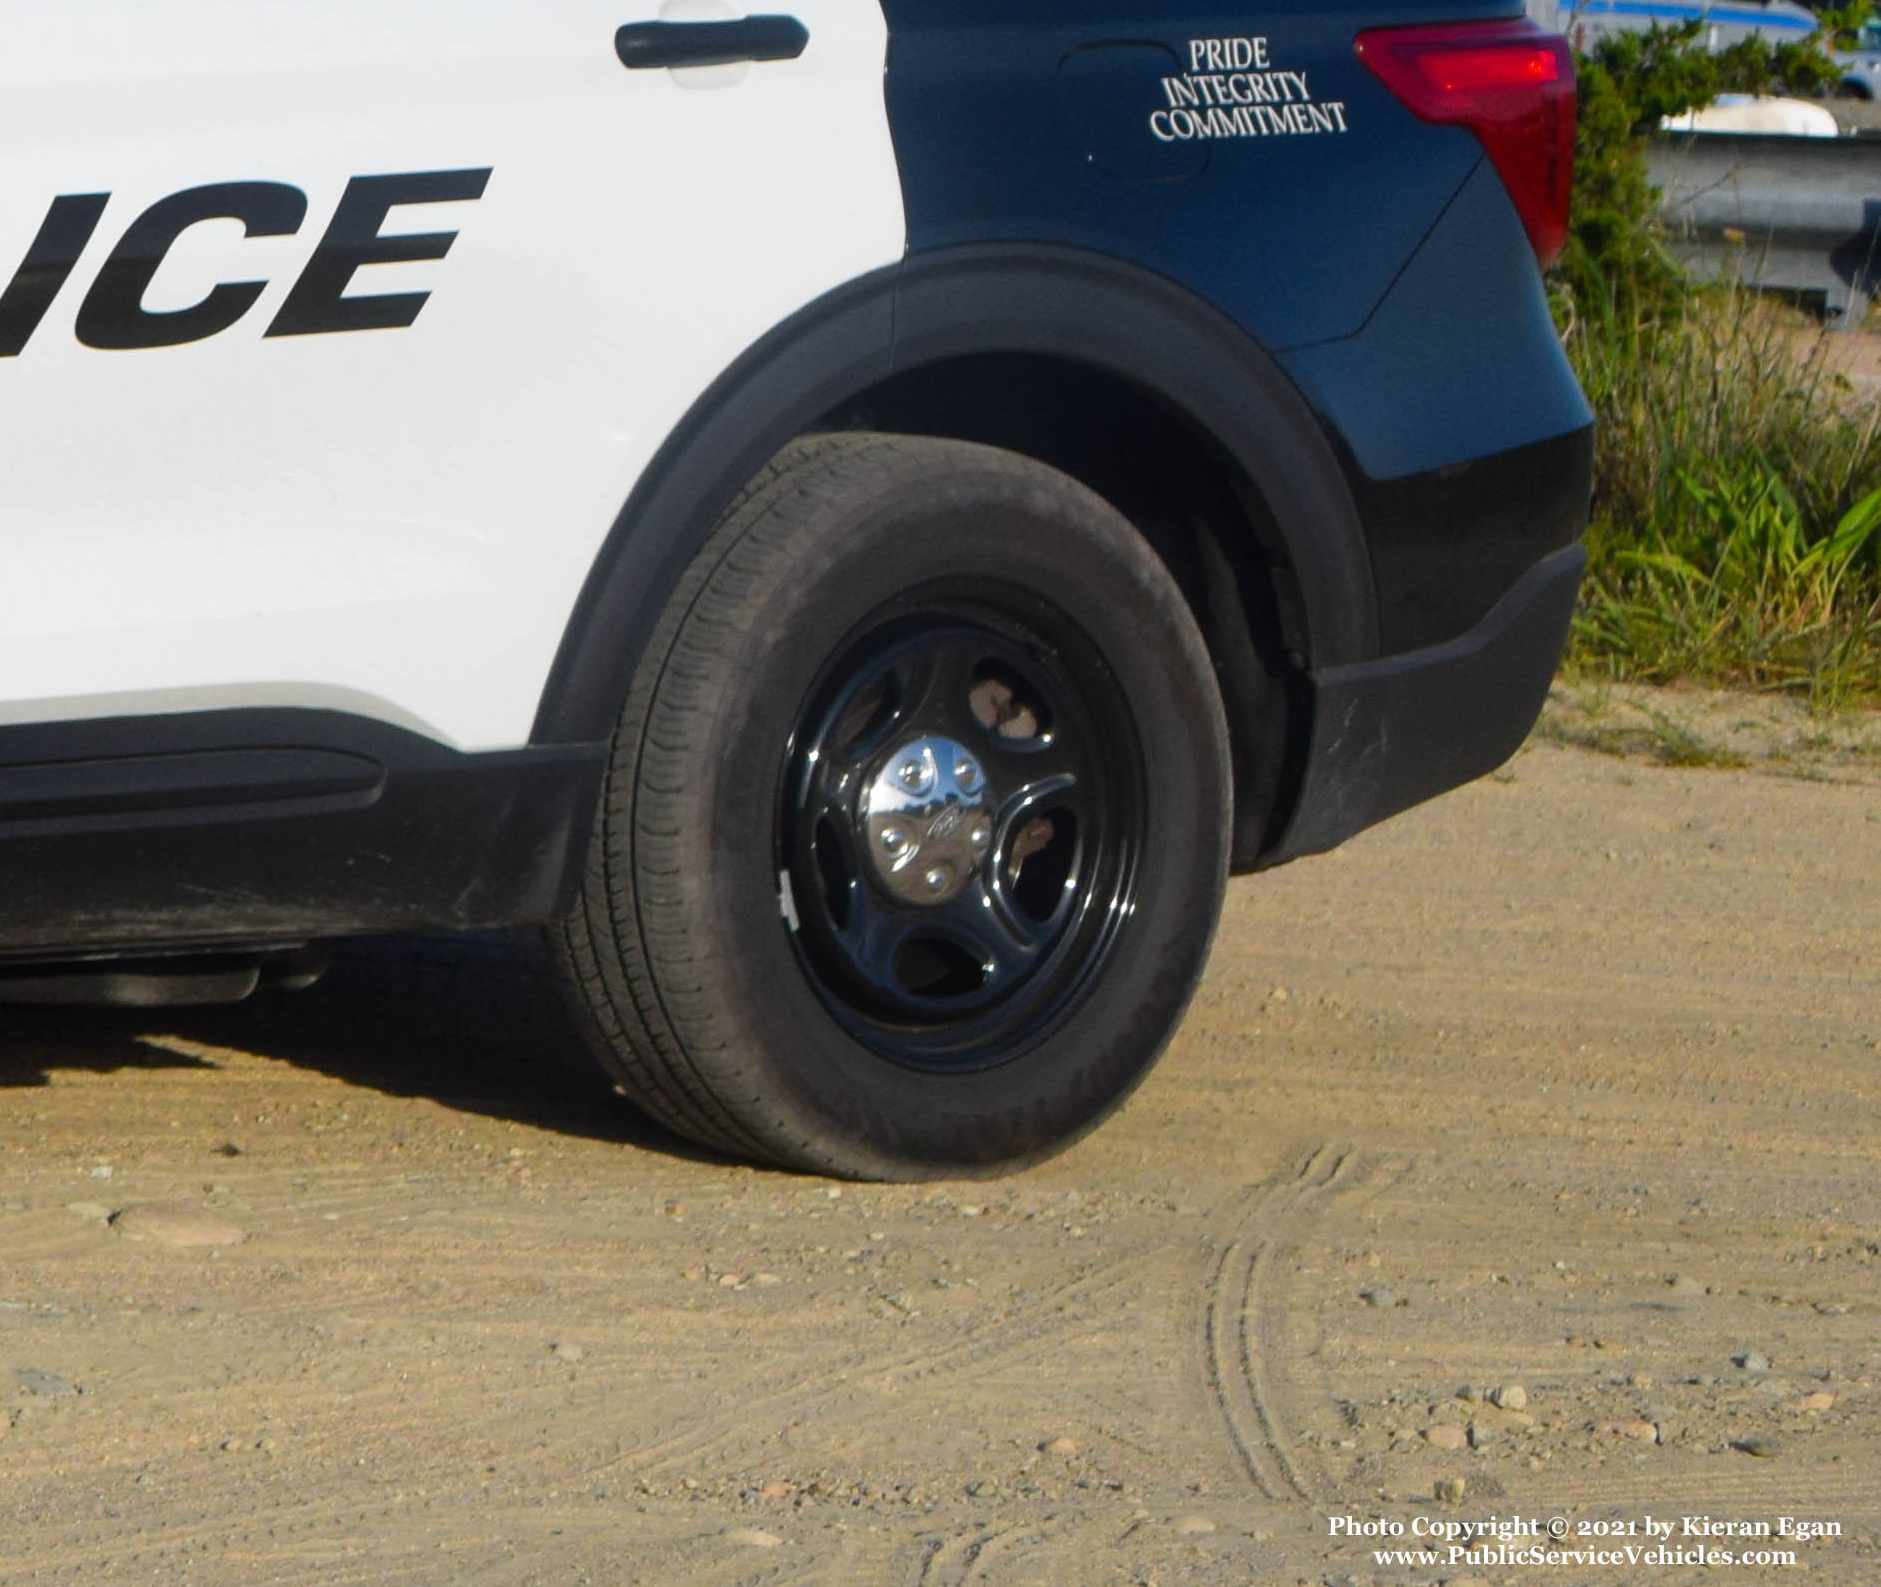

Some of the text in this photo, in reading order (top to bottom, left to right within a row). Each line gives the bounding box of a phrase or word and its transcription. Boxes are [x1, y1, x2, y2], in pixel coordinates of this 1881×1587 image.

[1190, 37, 1270, 71] PRIDE
[1161, 71, 1311, 107] INTEGRITY
[1150, 101, 1348, 142] COMMITMENT
